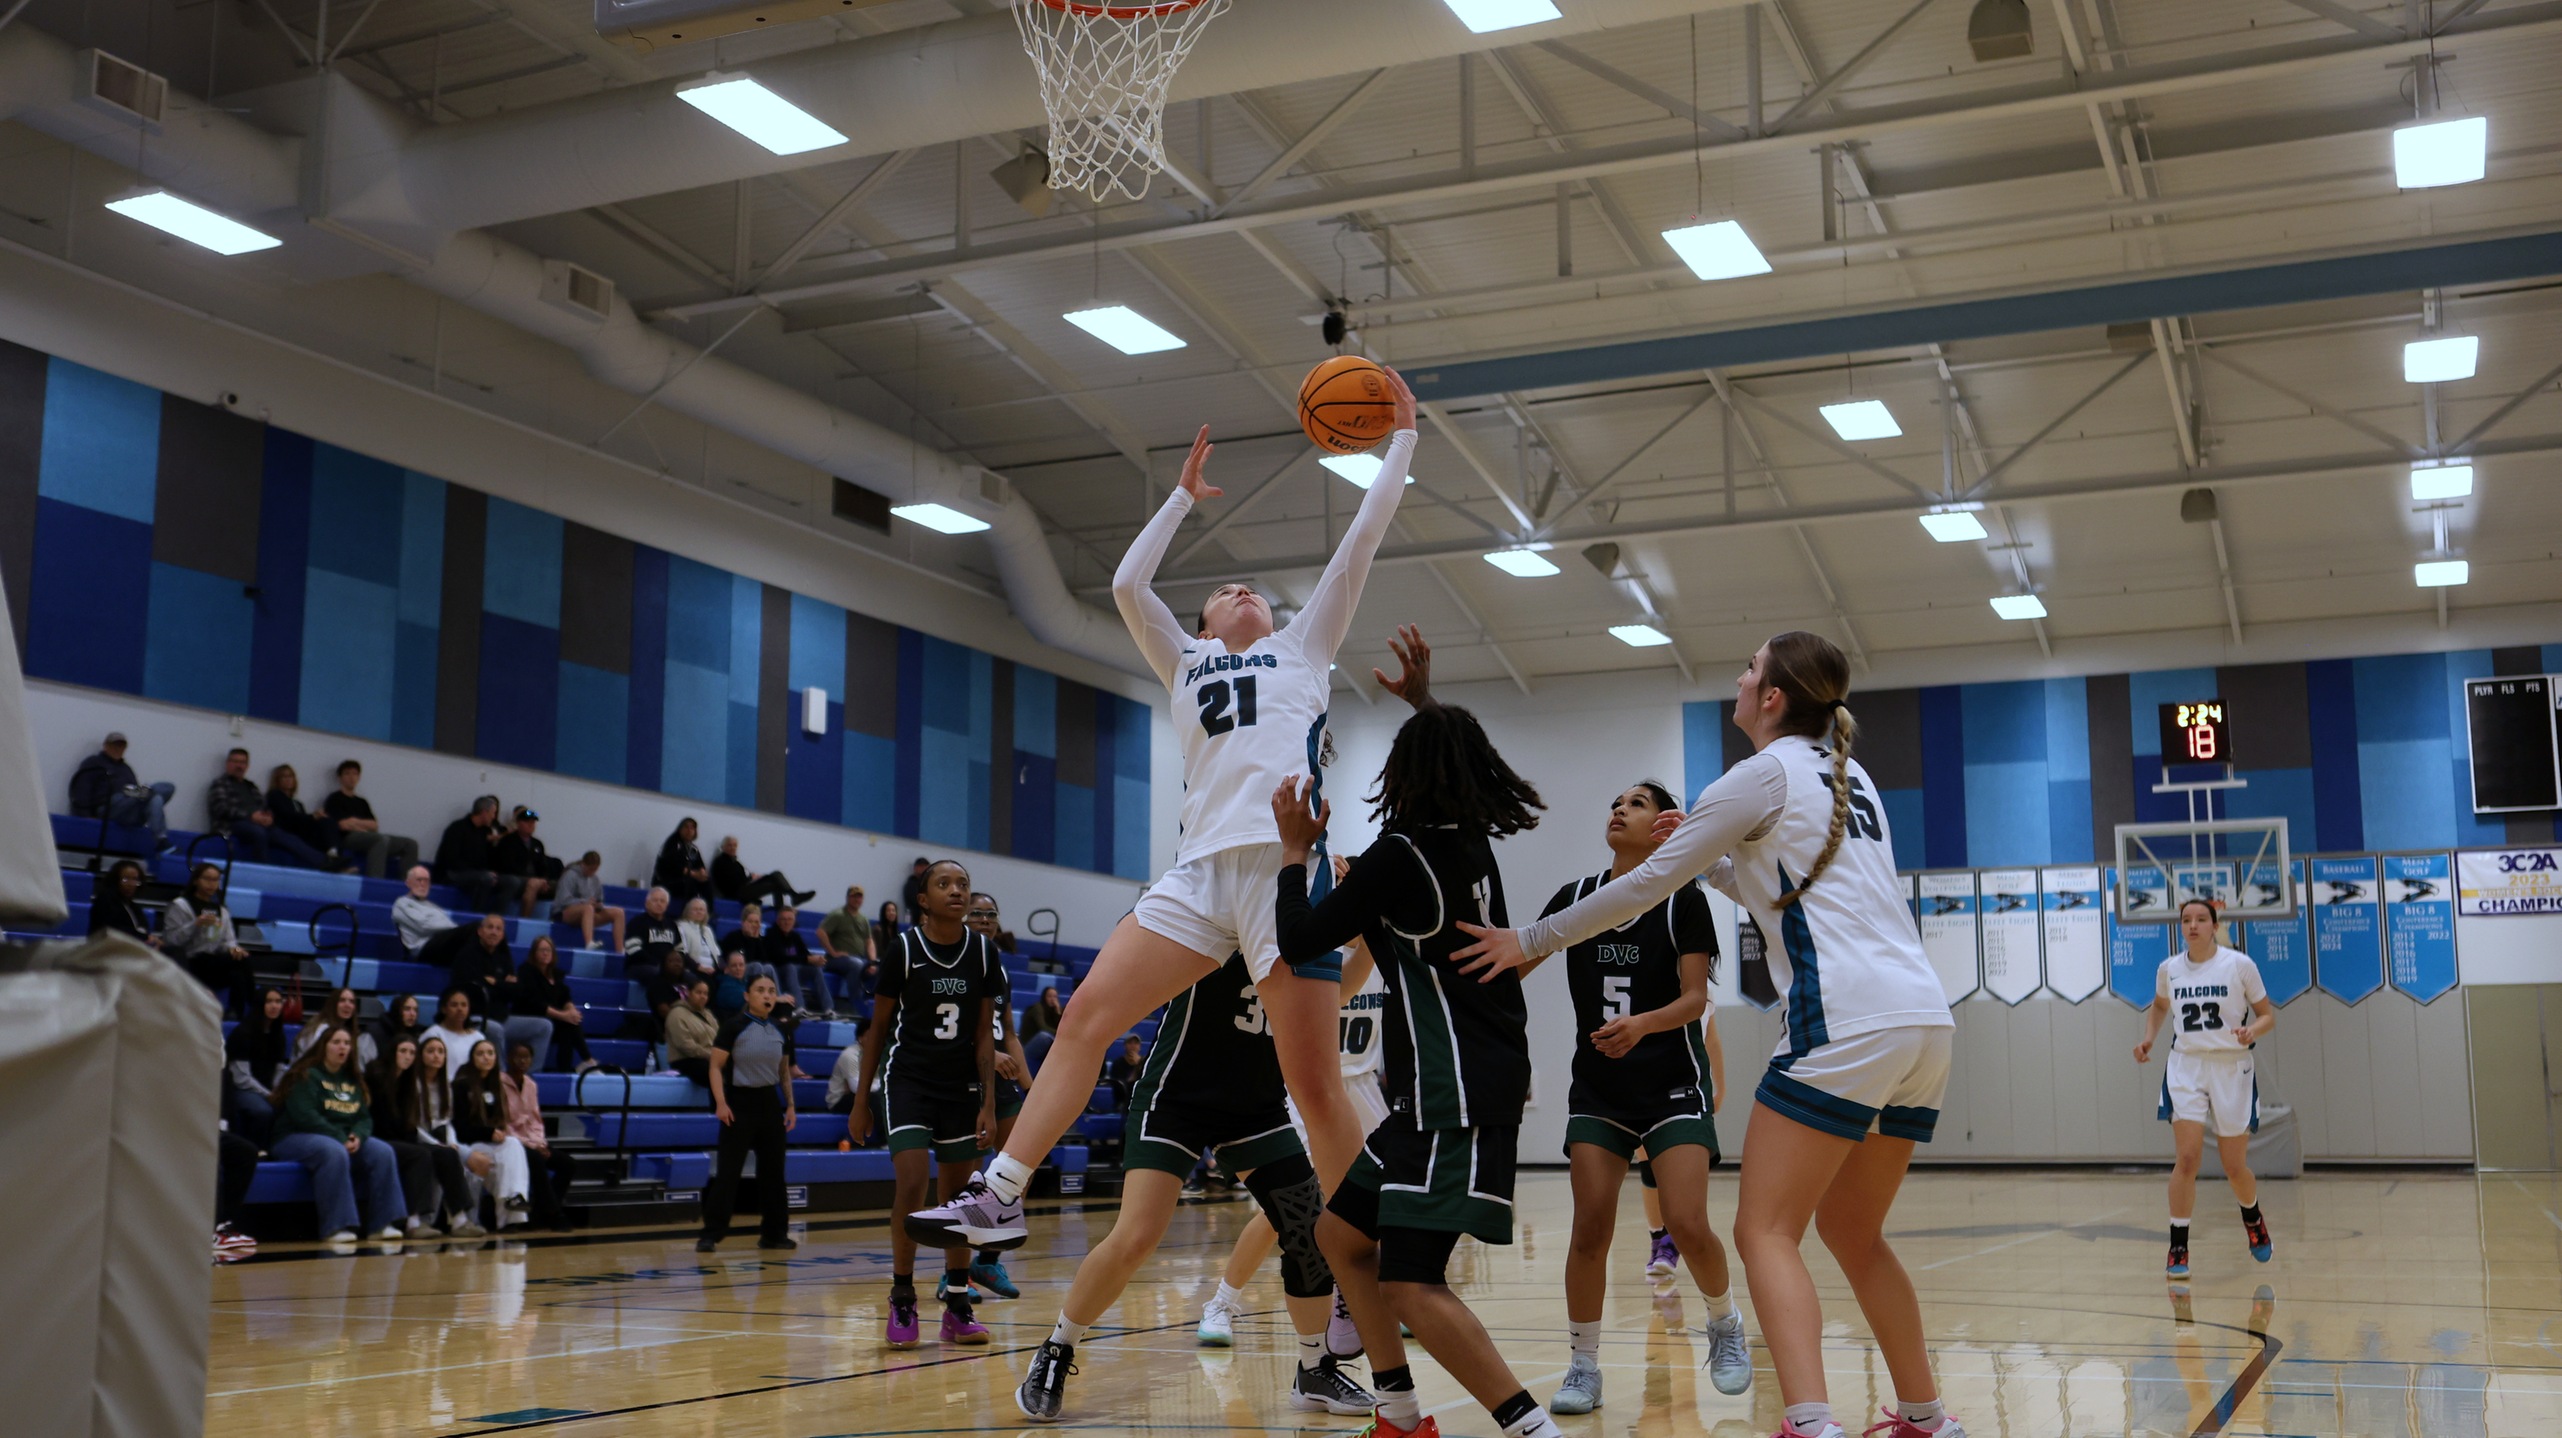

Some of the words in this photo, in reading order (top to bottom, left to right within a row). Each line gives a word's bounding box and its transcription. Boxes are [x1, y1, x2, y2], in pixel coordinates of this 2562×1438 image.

[1185, 654, 1277, 687] FALCONS
[2474, 684, 2493, 696] PLYR
[2501, 683, 2515, 695] FLS
[2525, 681, 2540, 693] PTS
[1197, 674, 1256, 739] 21
[2177, 704, 2222, 727] 2:24
[2188, 724, 2216, 759] 18
[2498, 852, 2559, 873] 3C2A
[2509, 873, 2550, 888] 2023
[2332, 907, 2351, 918] BIG
[2355, 906, 2362, 917] 8
[2404, 906, 2425, 916] BIG
[2428, 905, 2436, 915] 8
[1597, 943, 1639, 965] DVC
[932, 978, 967, 995] DVC
[2174, 985, 2228, 1000] FALCONS
[1234, 984, 1274, 1036] 3
[1603, 976, 1631, 1023] 5
[934, 1003, 959, 1040] 3
[2181, 1002, 2223, 1032] 23
